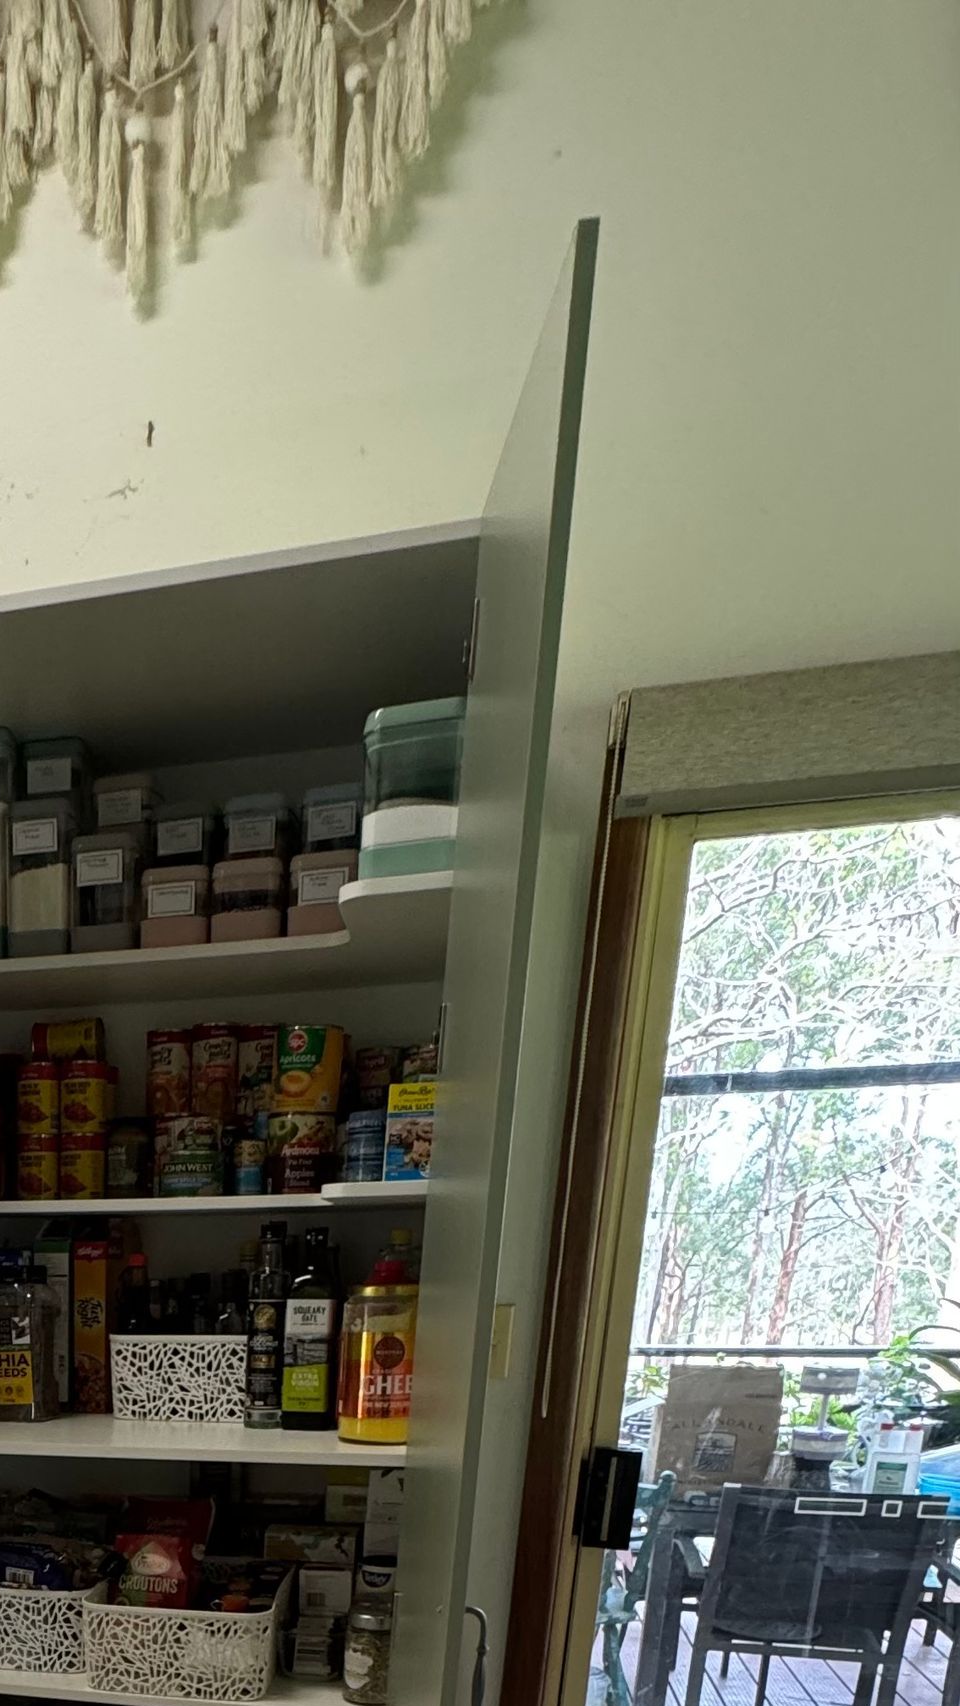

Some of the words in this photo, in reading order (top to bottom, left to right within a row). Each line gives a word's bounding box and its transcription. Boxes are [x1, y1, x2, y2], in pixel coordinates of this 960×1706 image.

[187, 1162, 214, 1172] WEST
[293, 1306, 326, 1314] SQUEAKY
[301, 1314, 318, 1323] GATE
[364, 1375, 413, 1395] GHEE
[118, 1574, 178, 1594] CROUTONS
